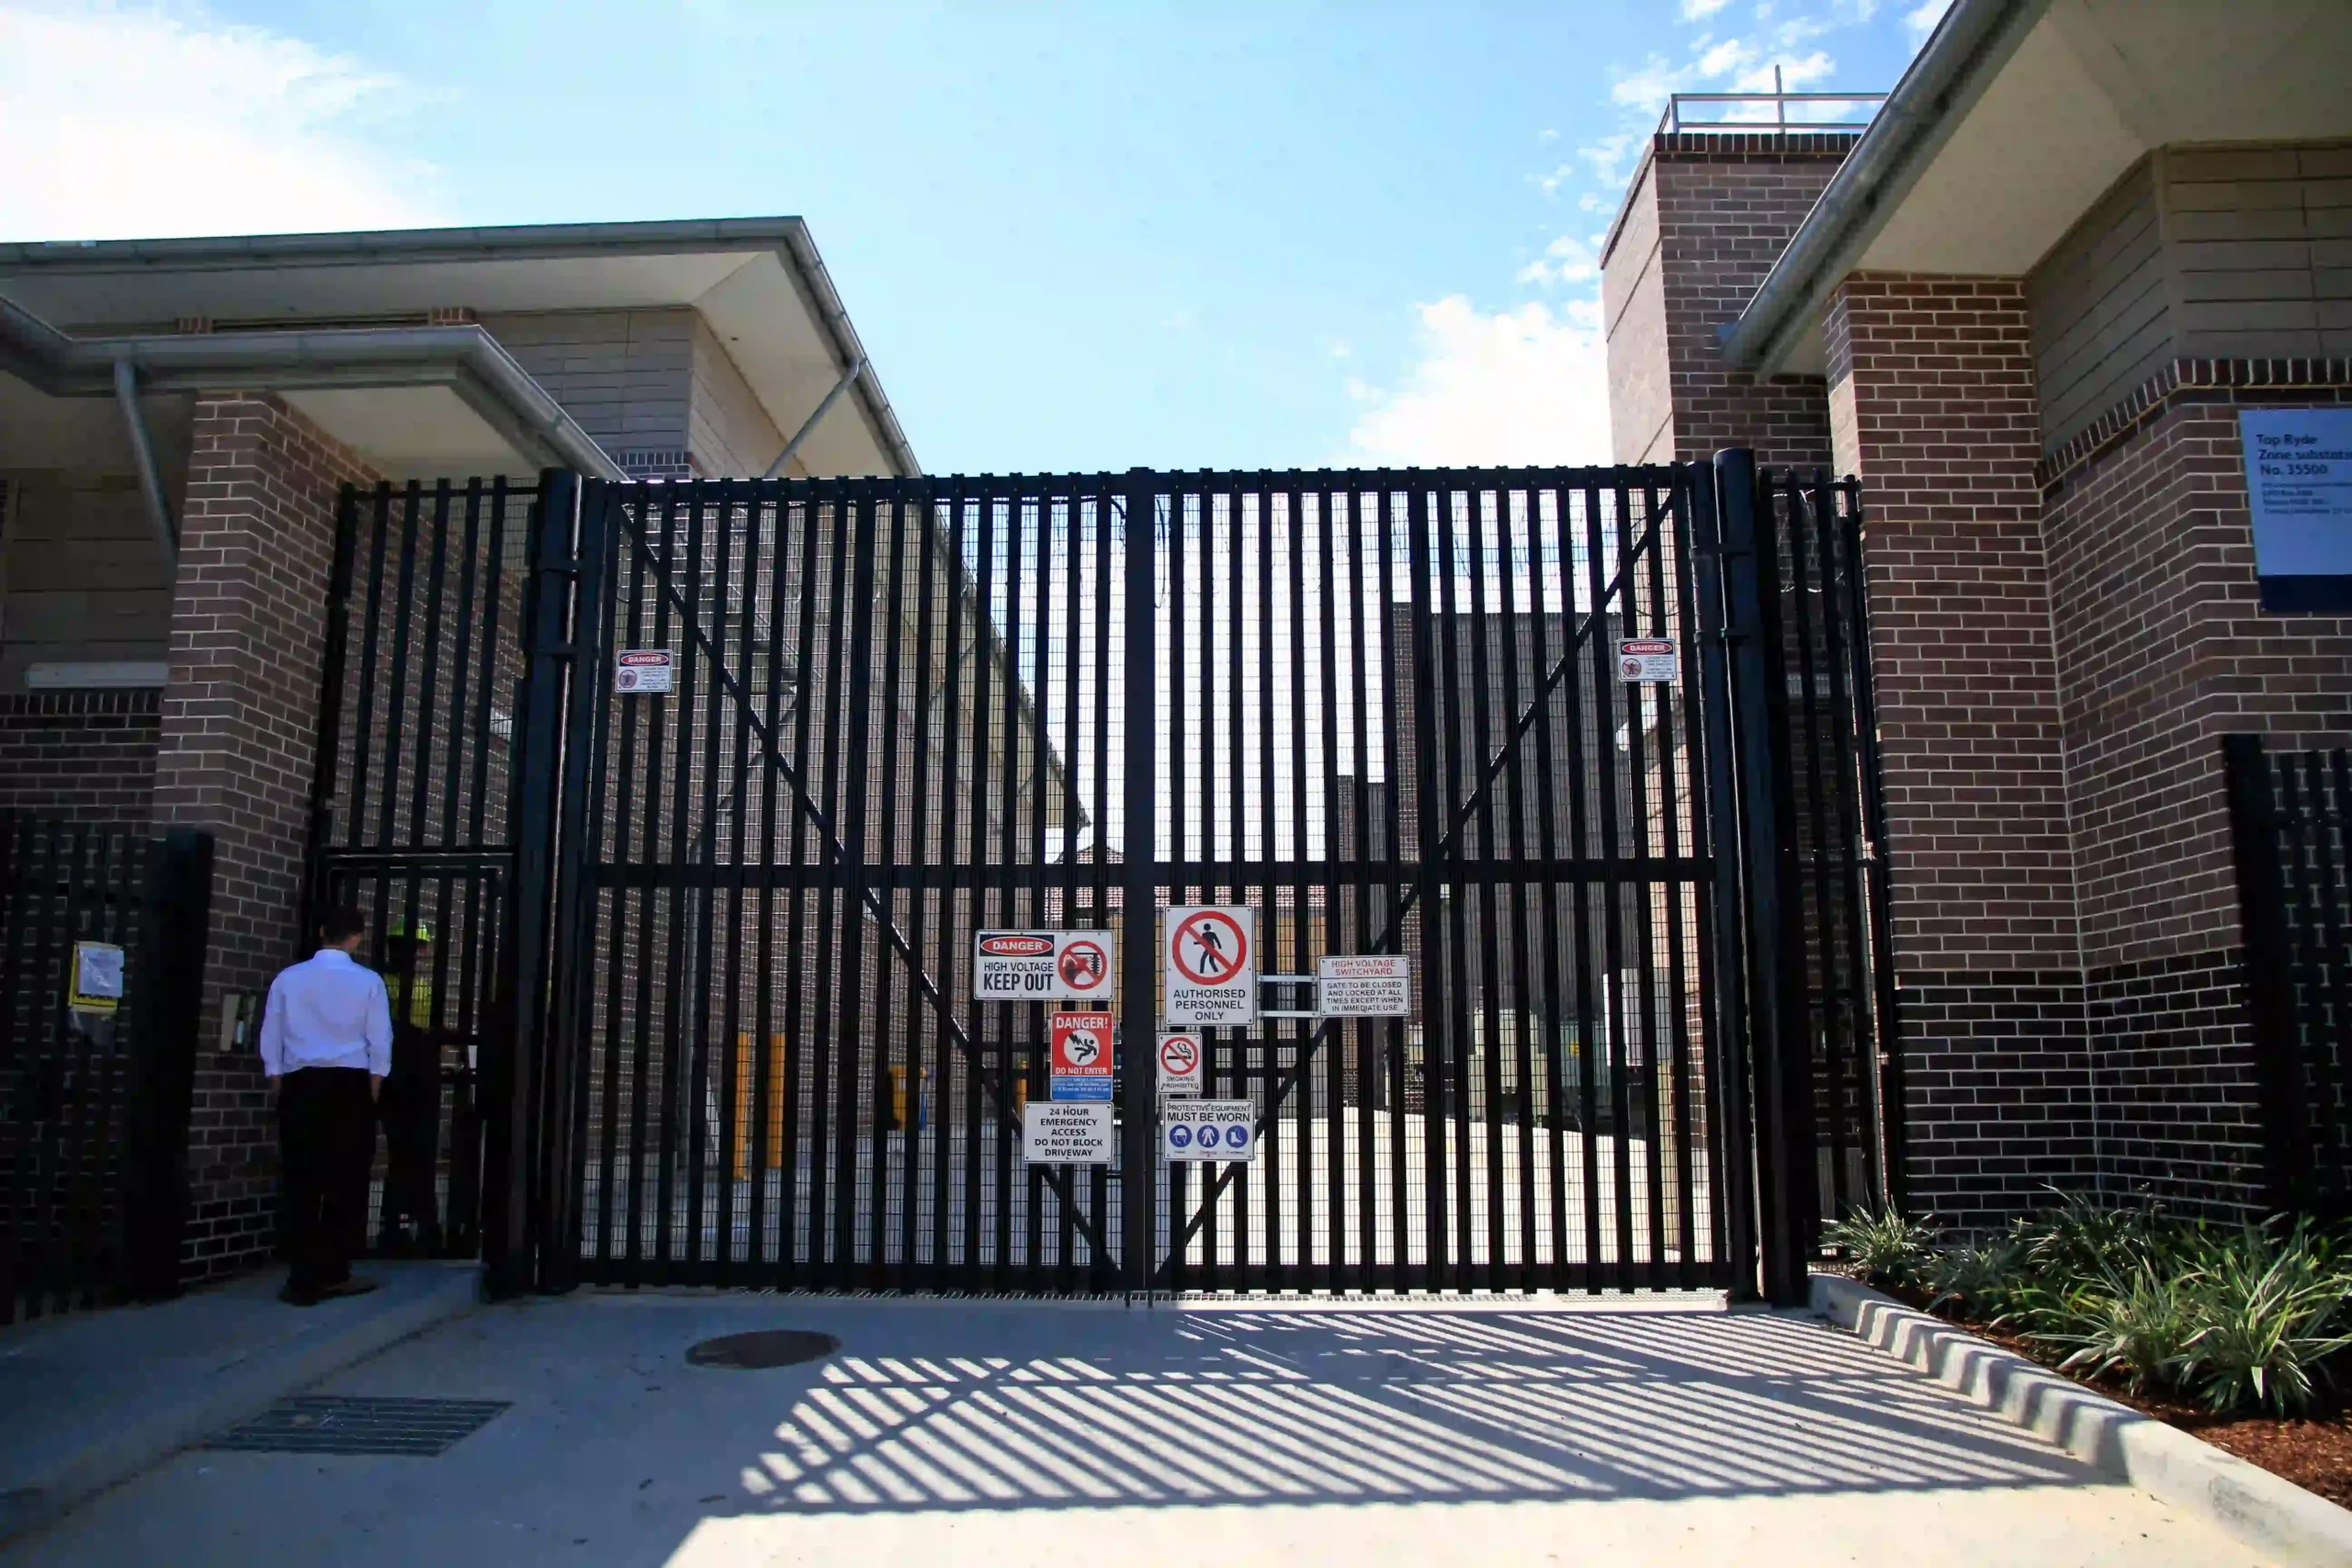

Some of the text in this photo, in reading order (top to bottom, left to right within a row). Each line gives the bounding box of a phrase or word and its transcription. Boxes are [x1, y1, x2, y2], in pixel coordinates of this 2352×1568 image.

[2256, 434, 2318, 448] Top Ryde
[2257, 449, 2291, 459] Zone
[2260, 463, 2328, 475] No. 35500
[992, 941, 1043, 951] DANGER
[984, 962, 1054, 972] HIGH VOLTAGE
[1331, 959, 1396, 968] HIGH VOLTAGE
[1335, 967, 1393, 976] SWITCHYARD
[983, 973, 1054, 991] KEEP OUT
[1173, 988, 1246, 998] AUTHORISED
[1175, 1000, 1244, 1010] PERSONNEL
[1194, 1011, 1224, 1021] ONLY
[1056, 1017, 1108, 1029] DANGER!
[1056, 1066, 1108, 1075] DO NOT ENTER
[1049, 1108, 1090, 1116] 24 HOUR
[1167, 1112, 1250, 1122] MUST BE WORN
[1040, 1118, 1097, 1126] EMERGENCY
[1051, 1128, 1087, 1136] ACCESS
[1035, 1138, 1102, 1146] DO NOT BLOCK
[1045, 1148, 1092, 1156] DRIVEWAY
